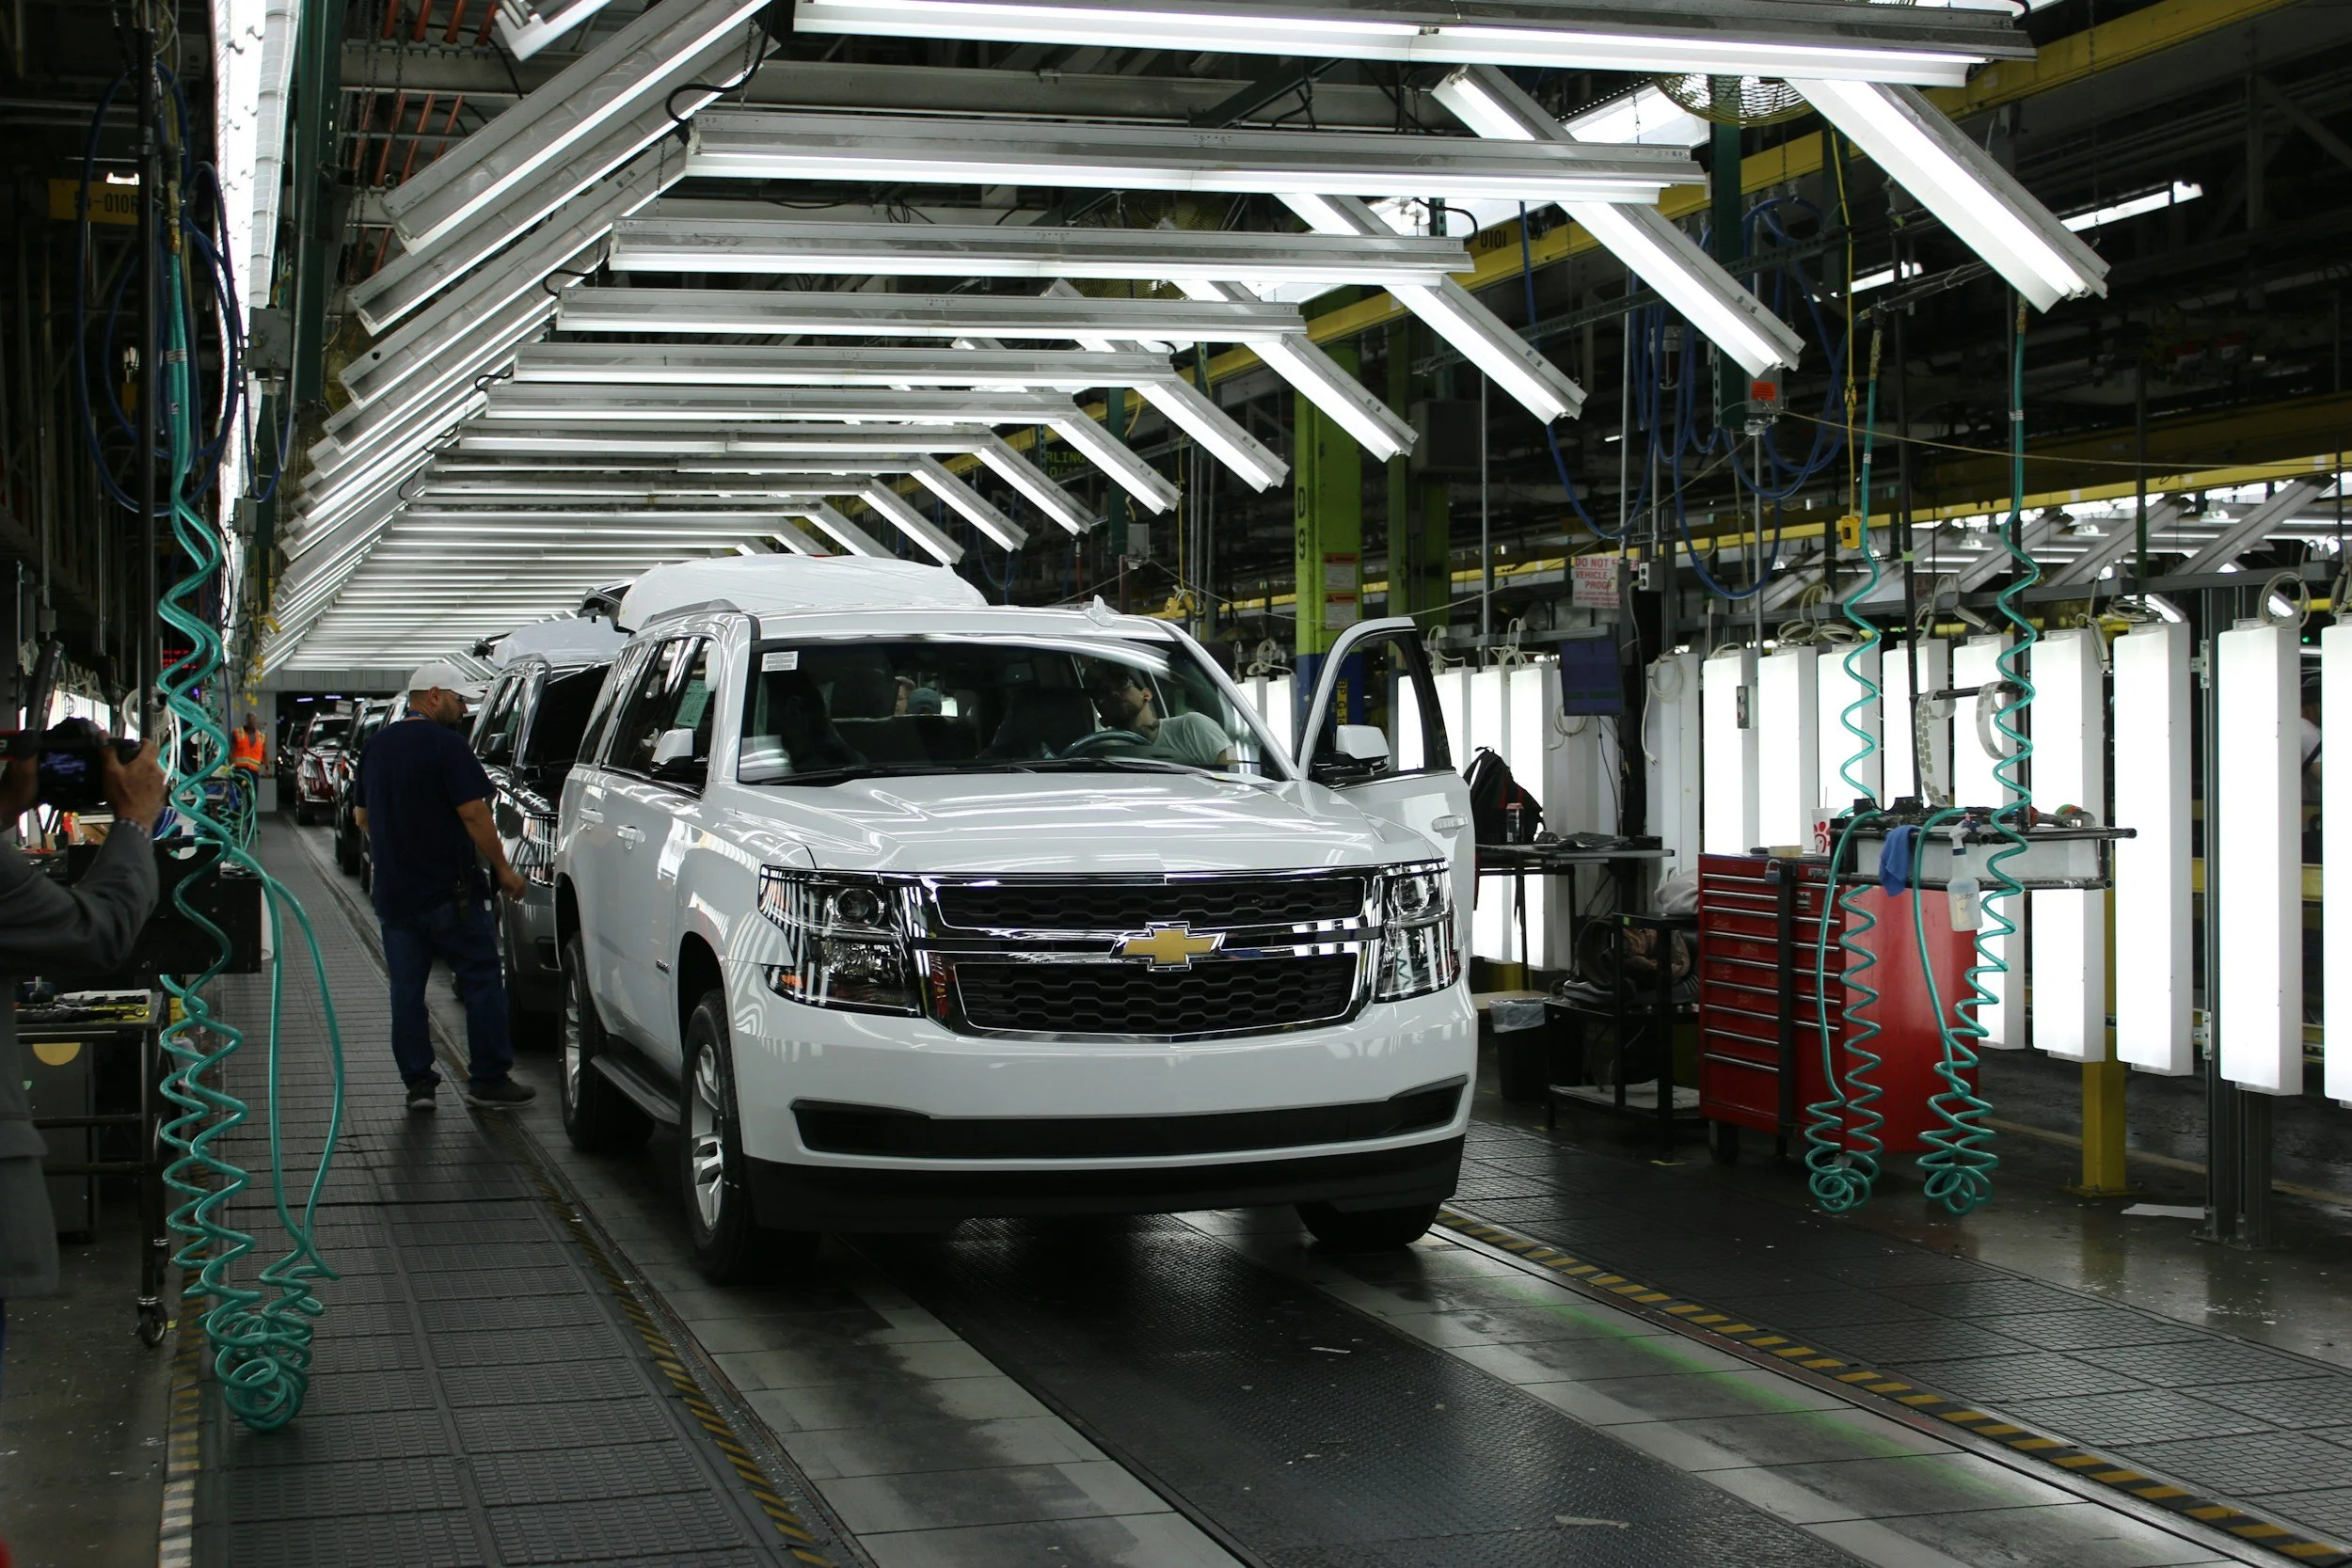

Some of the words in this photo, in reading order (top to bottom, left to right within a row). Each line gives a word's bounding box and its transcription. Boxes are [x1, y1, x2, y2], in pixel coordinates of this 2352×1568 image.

[1575, 557, 1587, 567] DO
[1591, 558, 1609, 567] NOT
[1575, 570, 1608, 579] VEHICLE
